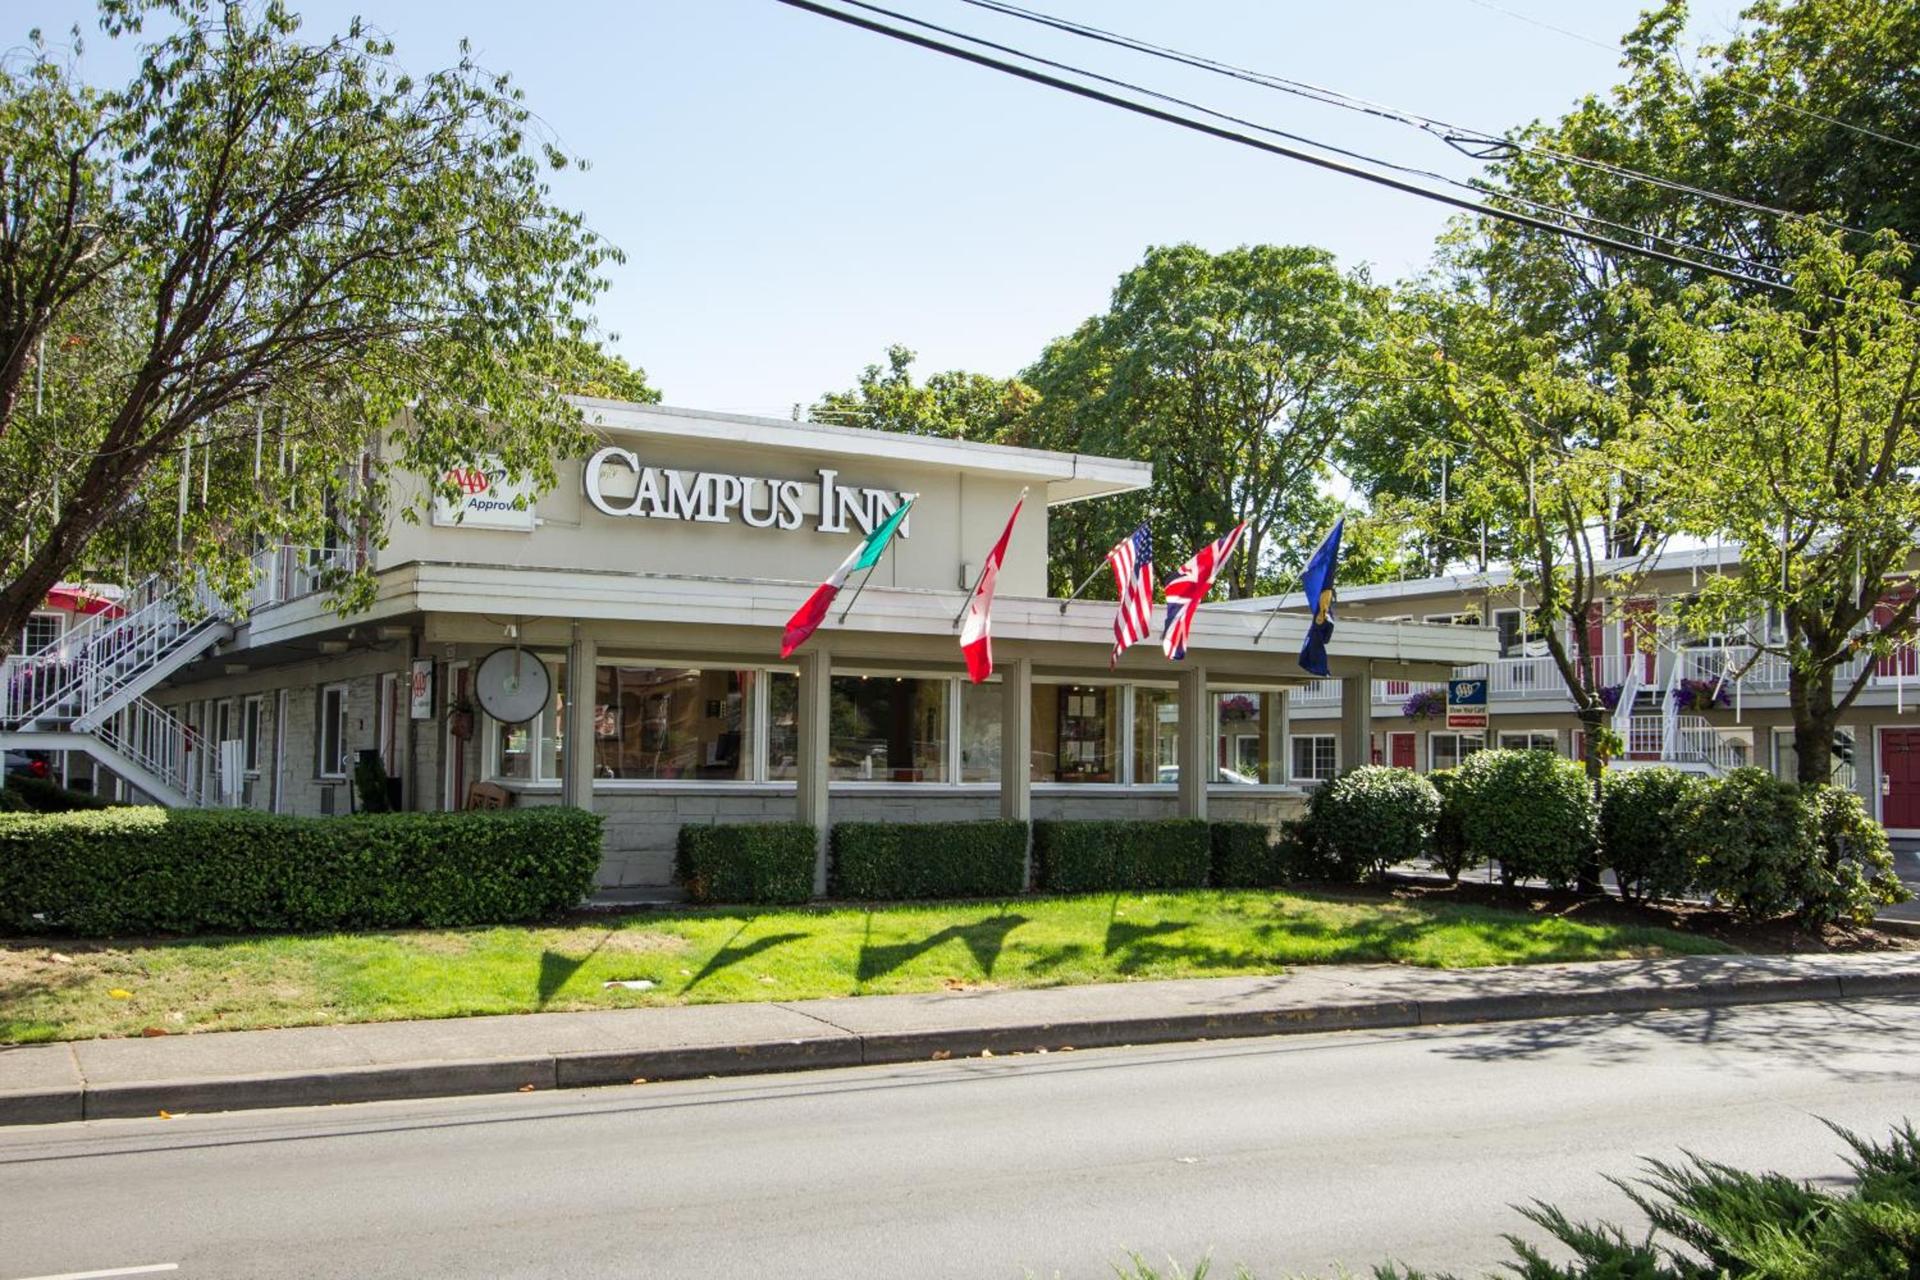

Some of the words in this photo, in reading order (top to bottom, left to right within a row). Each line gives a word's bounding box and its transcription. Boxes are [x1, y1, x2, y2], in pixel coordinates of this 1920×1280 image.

[468, 498, 527, 512] Approv
[584, 446, 804, 531] CAMPUS
[816, 469, 911, 539] INN
